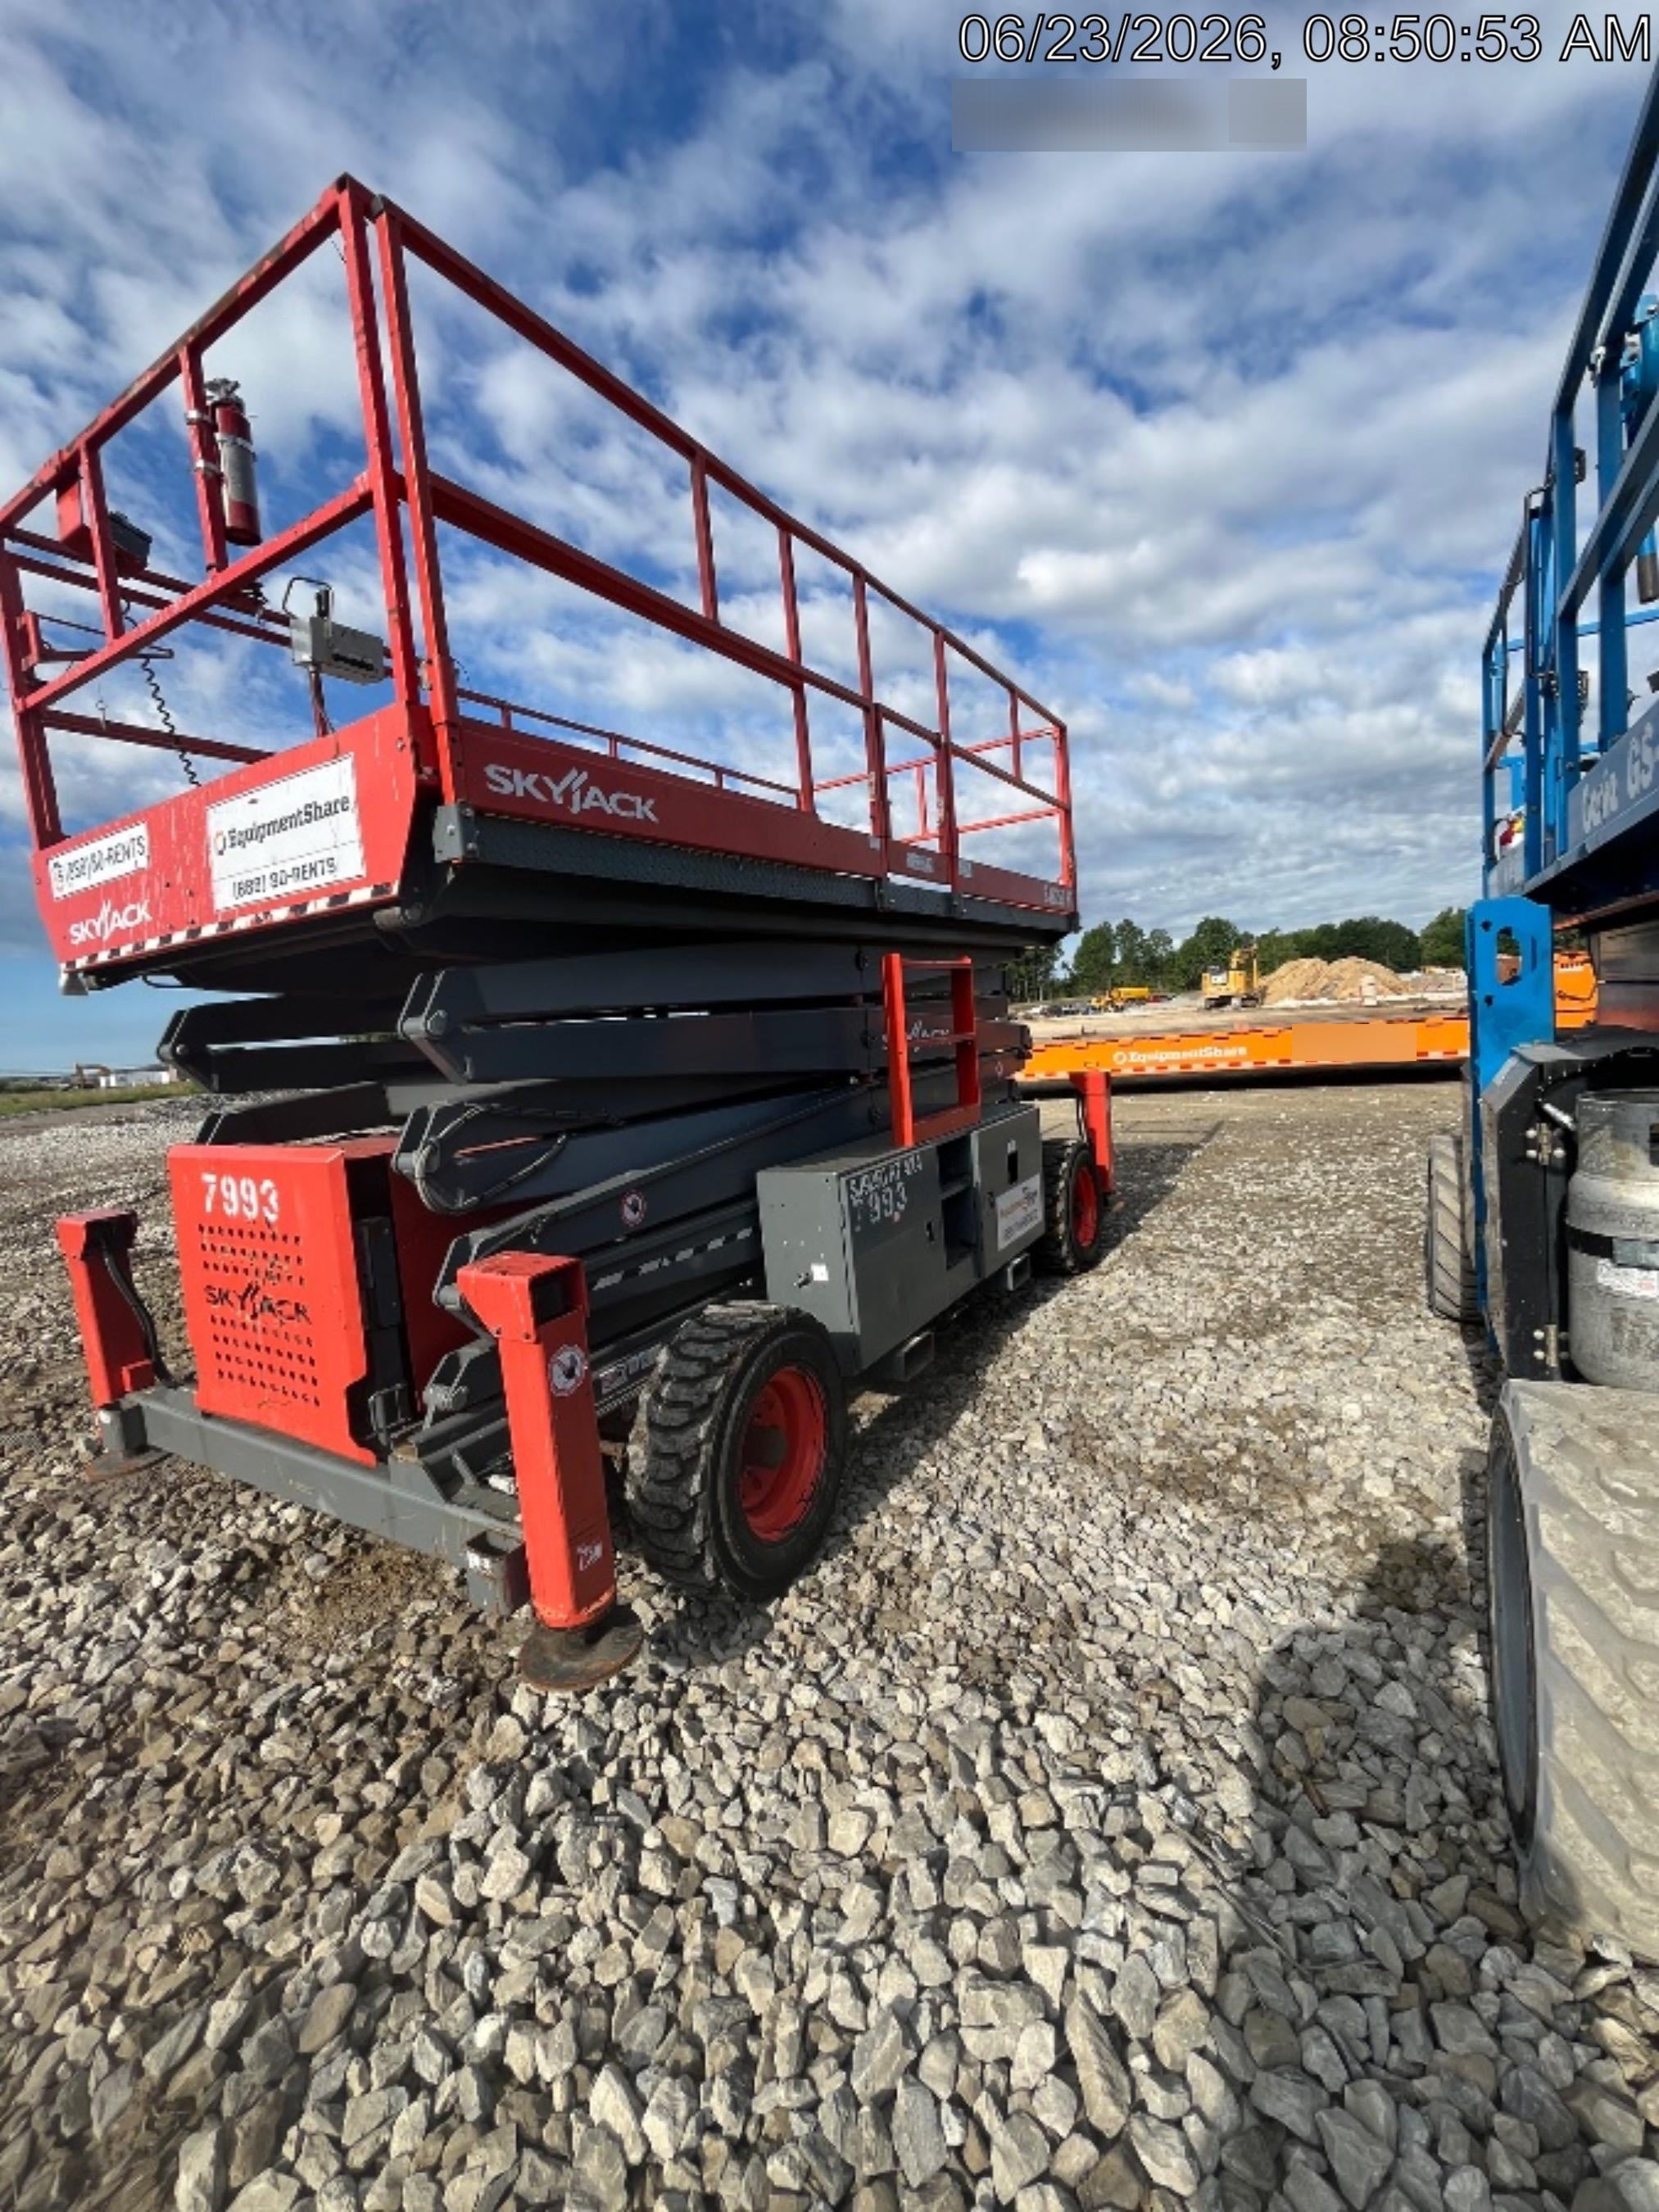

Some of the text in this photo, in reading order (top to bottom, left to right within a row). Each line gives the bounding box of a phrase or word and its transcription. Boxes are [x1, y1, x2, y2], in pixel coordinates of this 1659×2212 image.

[483, 763, 659, 823] SKYJACK
[228, 796, 351, 849] EquipmentShare
[70, 900, 153, 945] SKYJACK
[201, 1172, 279, 1222] 7993
[204, 1281, 312, 1324] SKYJACK
